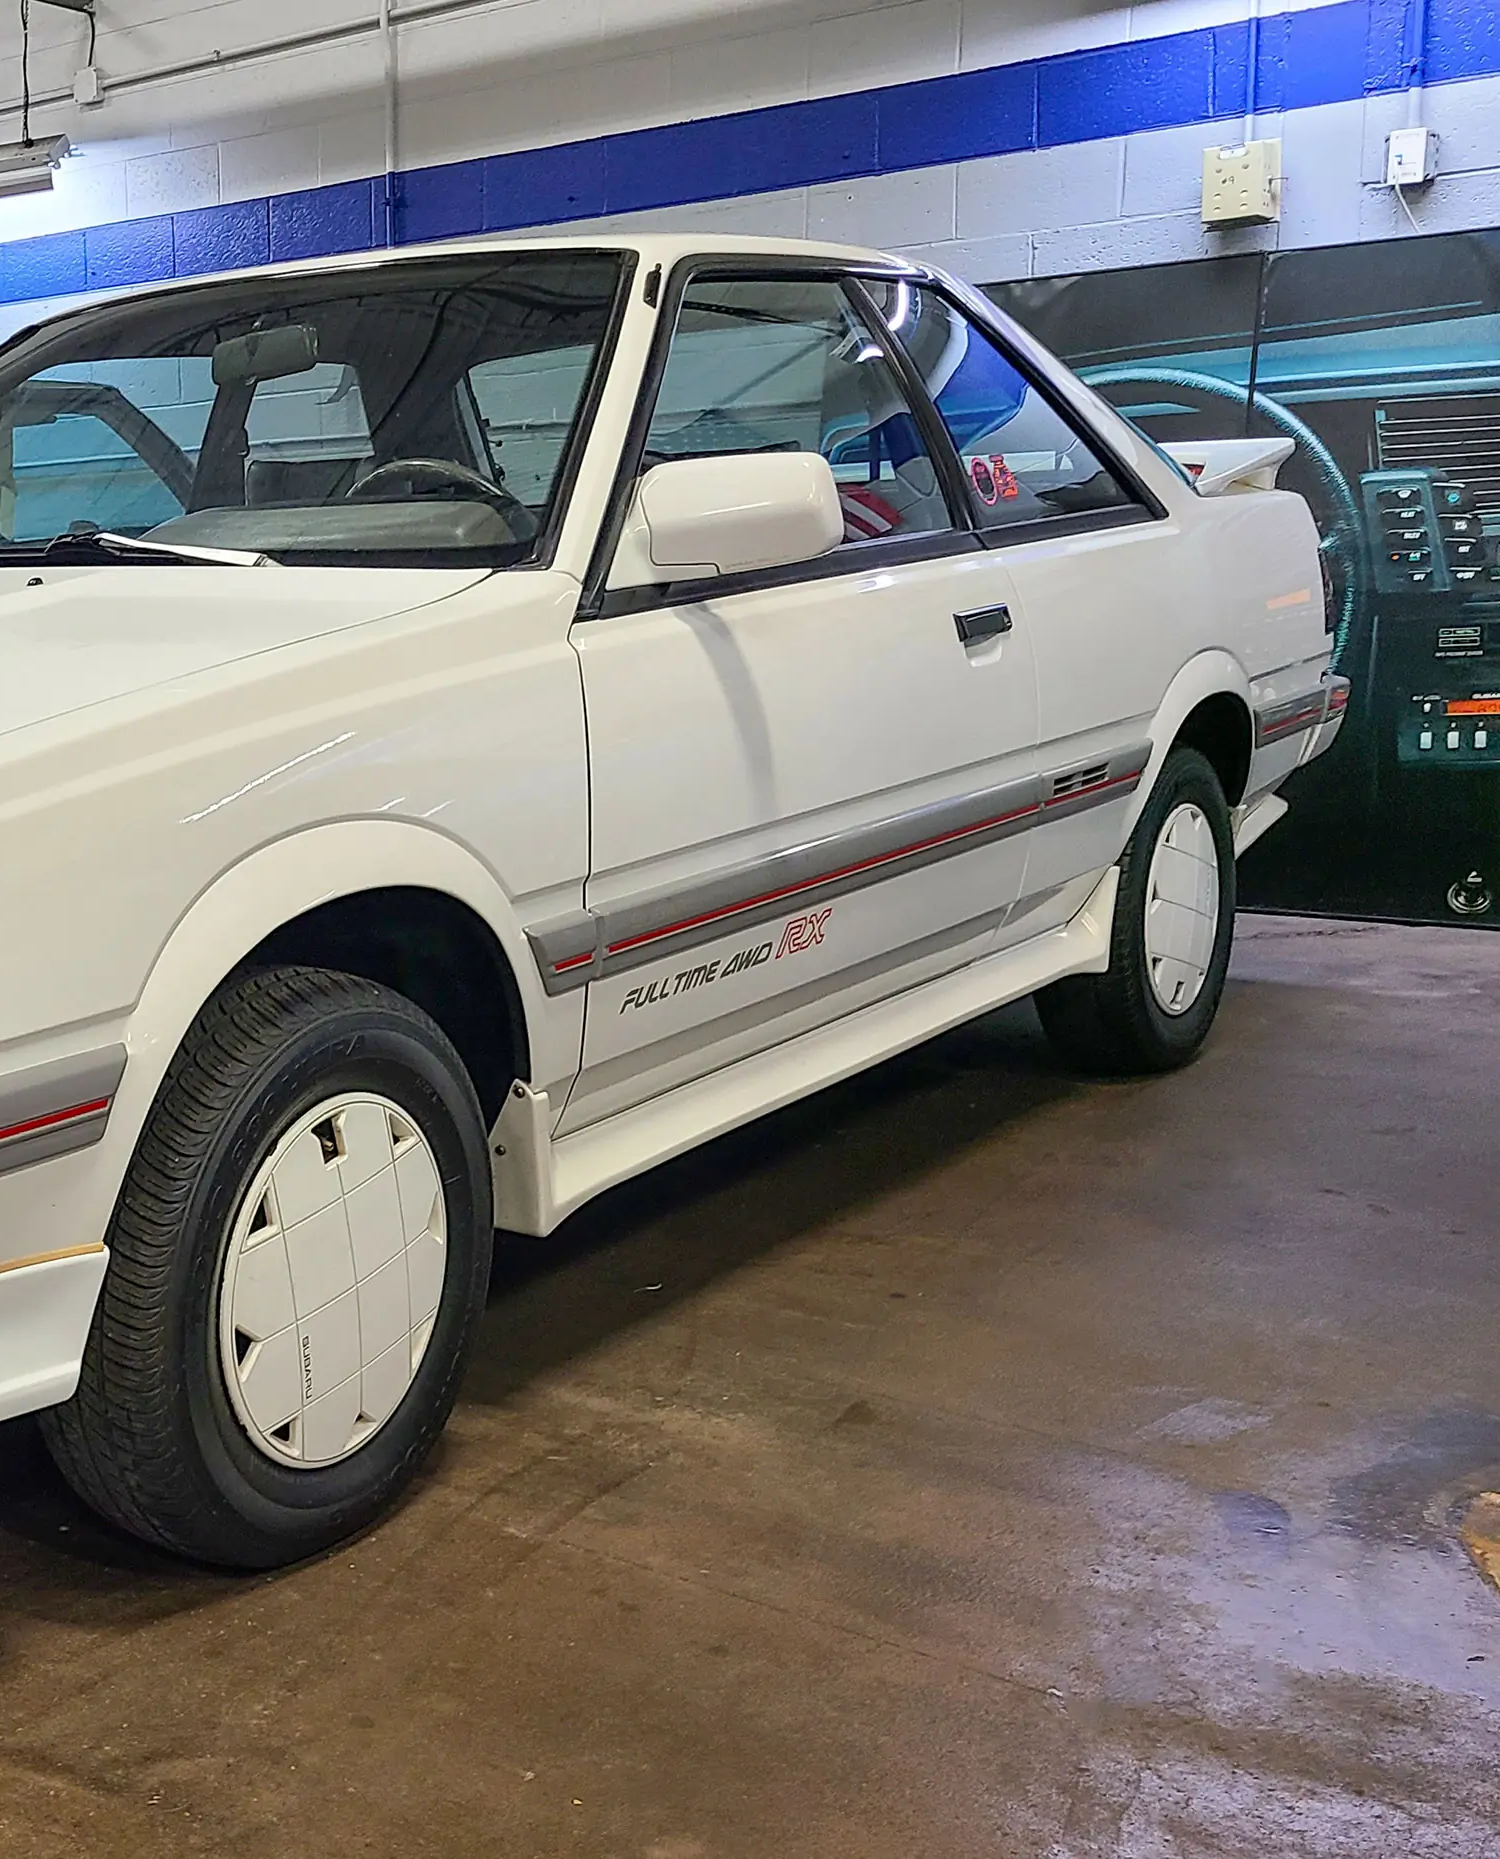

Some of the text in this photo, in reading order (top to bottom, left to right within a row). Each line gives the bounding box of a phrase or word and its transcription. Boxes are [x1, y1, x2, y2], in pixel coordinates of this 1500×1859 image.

[719, 941, 773, 979] AWD
[775, 907, 833, 960] RX
[301, 1335, 313, 1400] SUBARU
